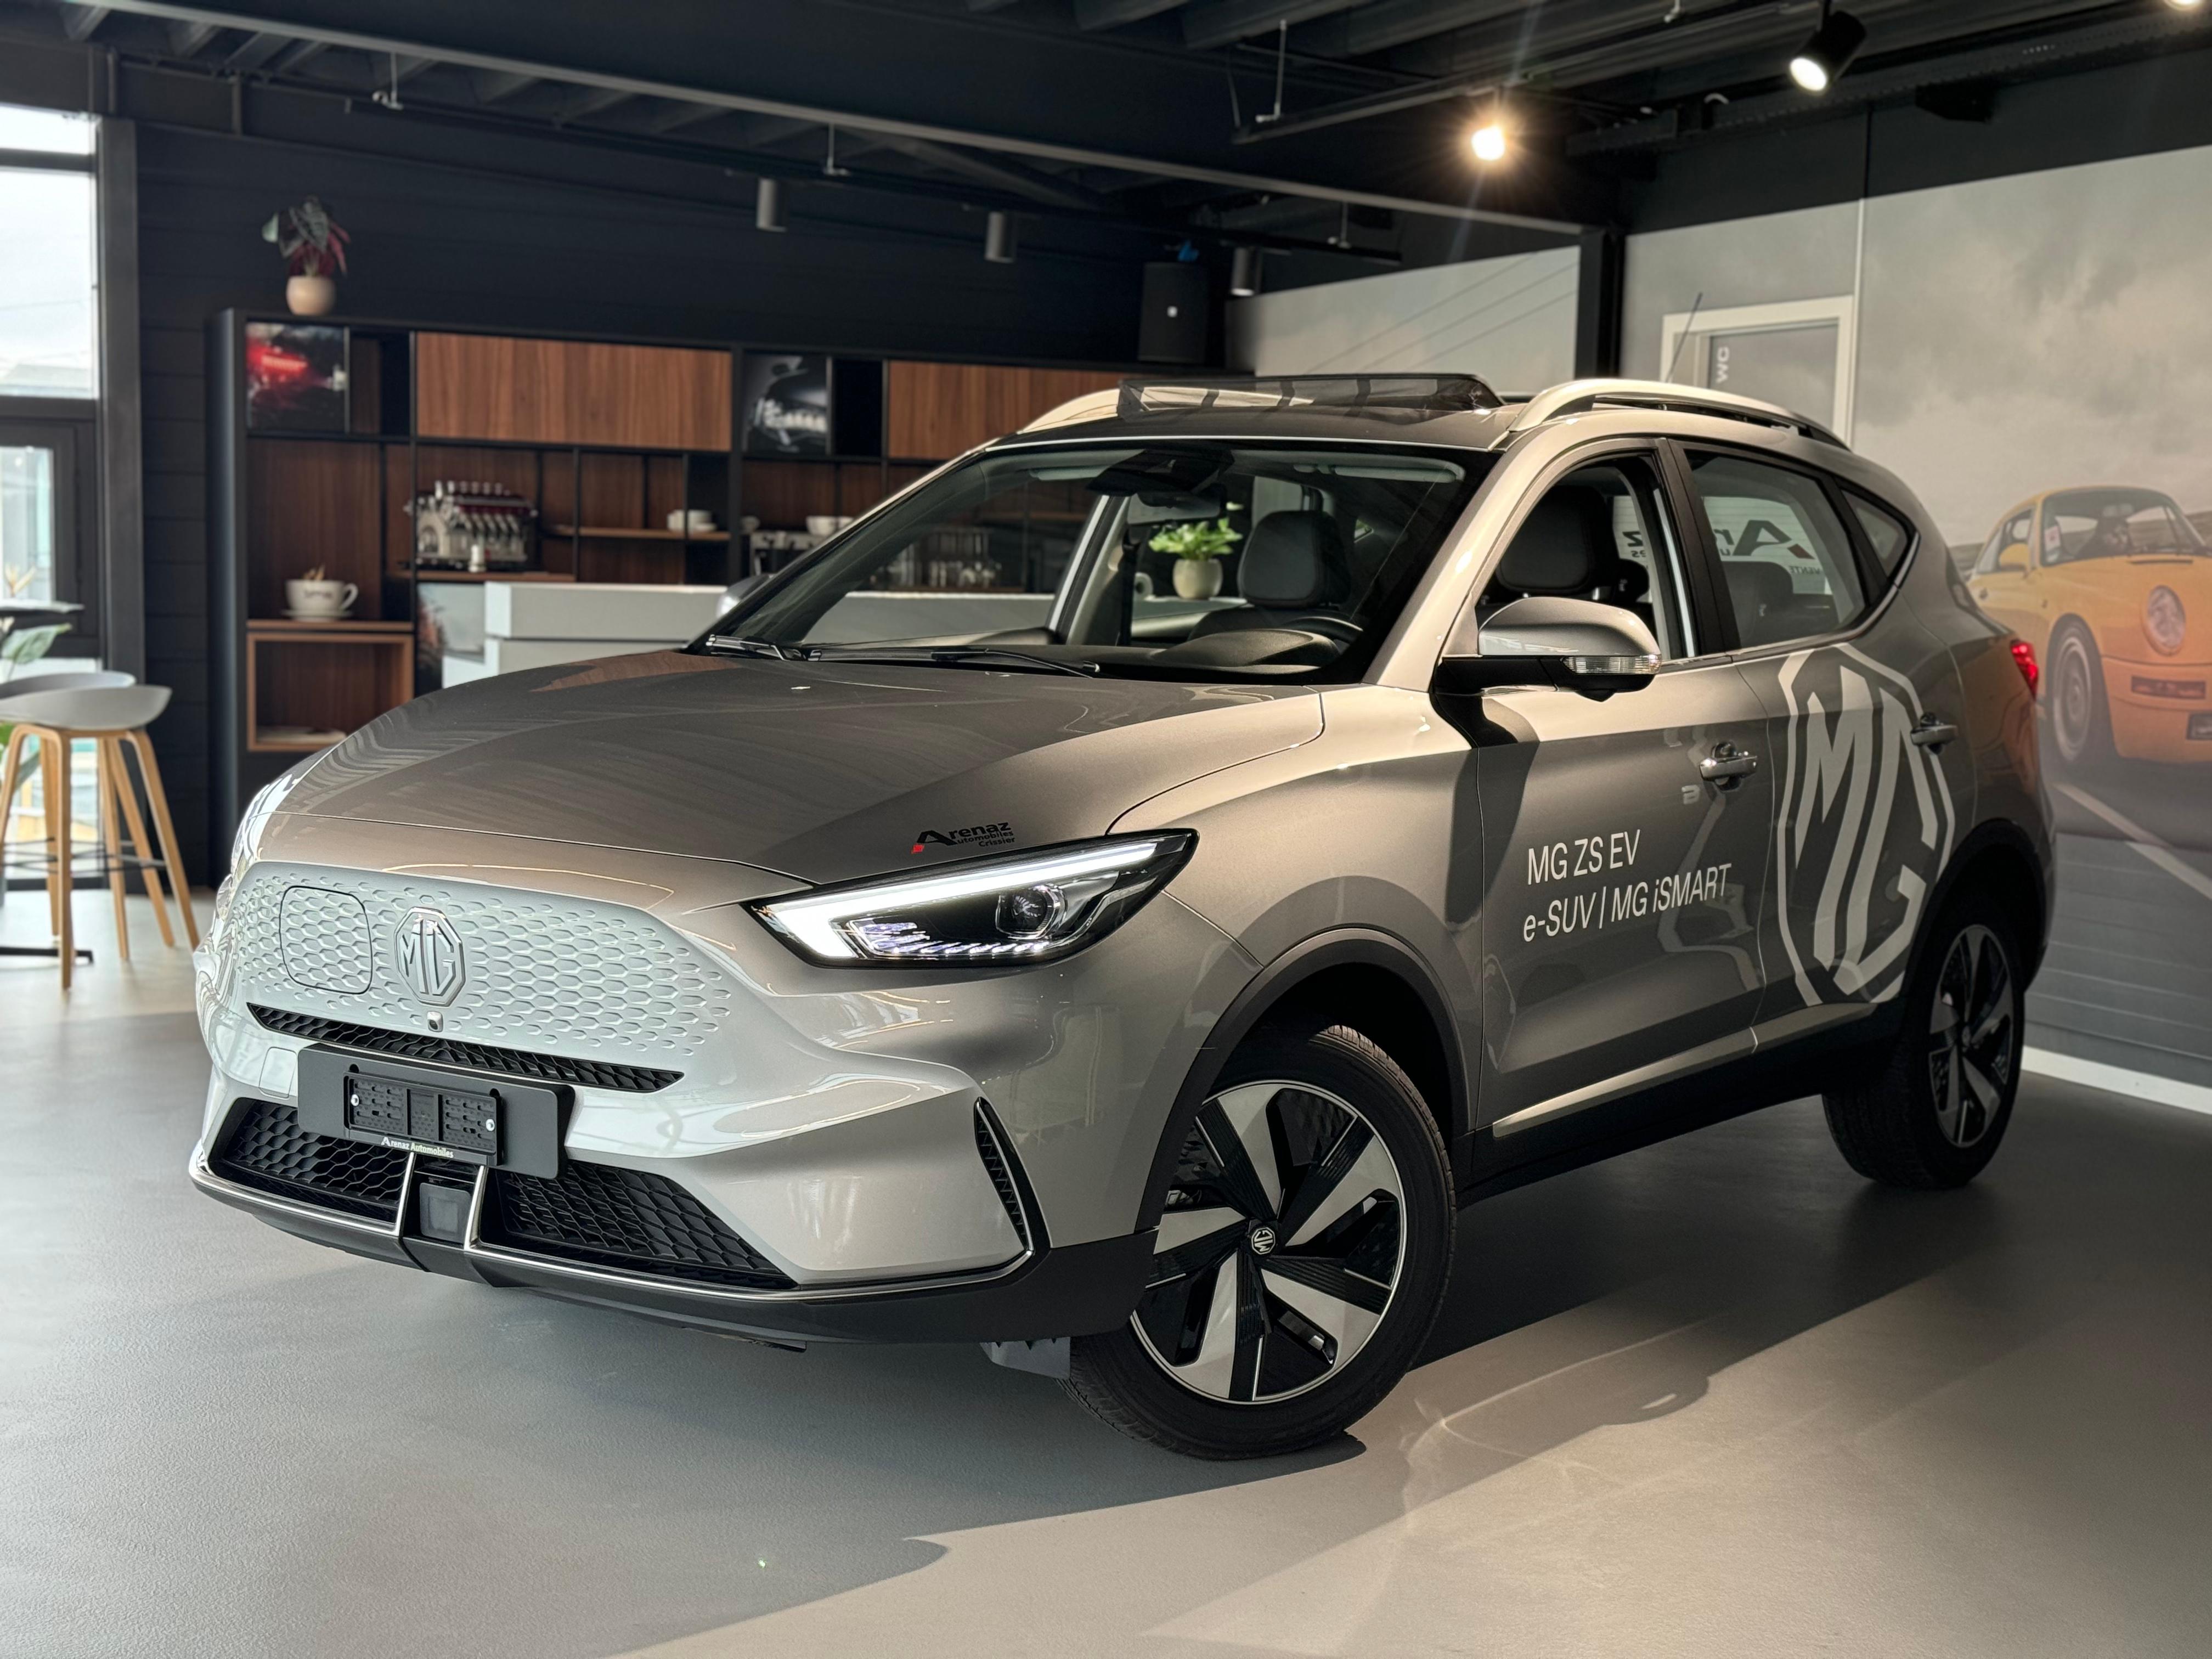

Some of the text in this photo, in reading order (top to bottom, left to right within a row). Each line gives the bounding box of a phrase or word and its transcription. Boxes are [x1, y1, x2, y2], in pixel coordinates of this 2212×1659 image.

[1716, 347, 1729, 383] WC
[917, 822, 1011, 845] Arenaz
[978, 837, 1015, 847] Crissier
[1796, 665, 1938, 996] MG
[1528, 829, 1640, 885] MG ZS EV
[1523, 892, 1597, 942] e-SUV
[1611, 882, 1648, 922] MG
[1652, 863, 1732, 913] iSMART
[399, 919, 456, 997] MG
[381, 1137, 454, 1159] Arenaz Automobiles
[1254, 1229, 1273, 1252] MG
